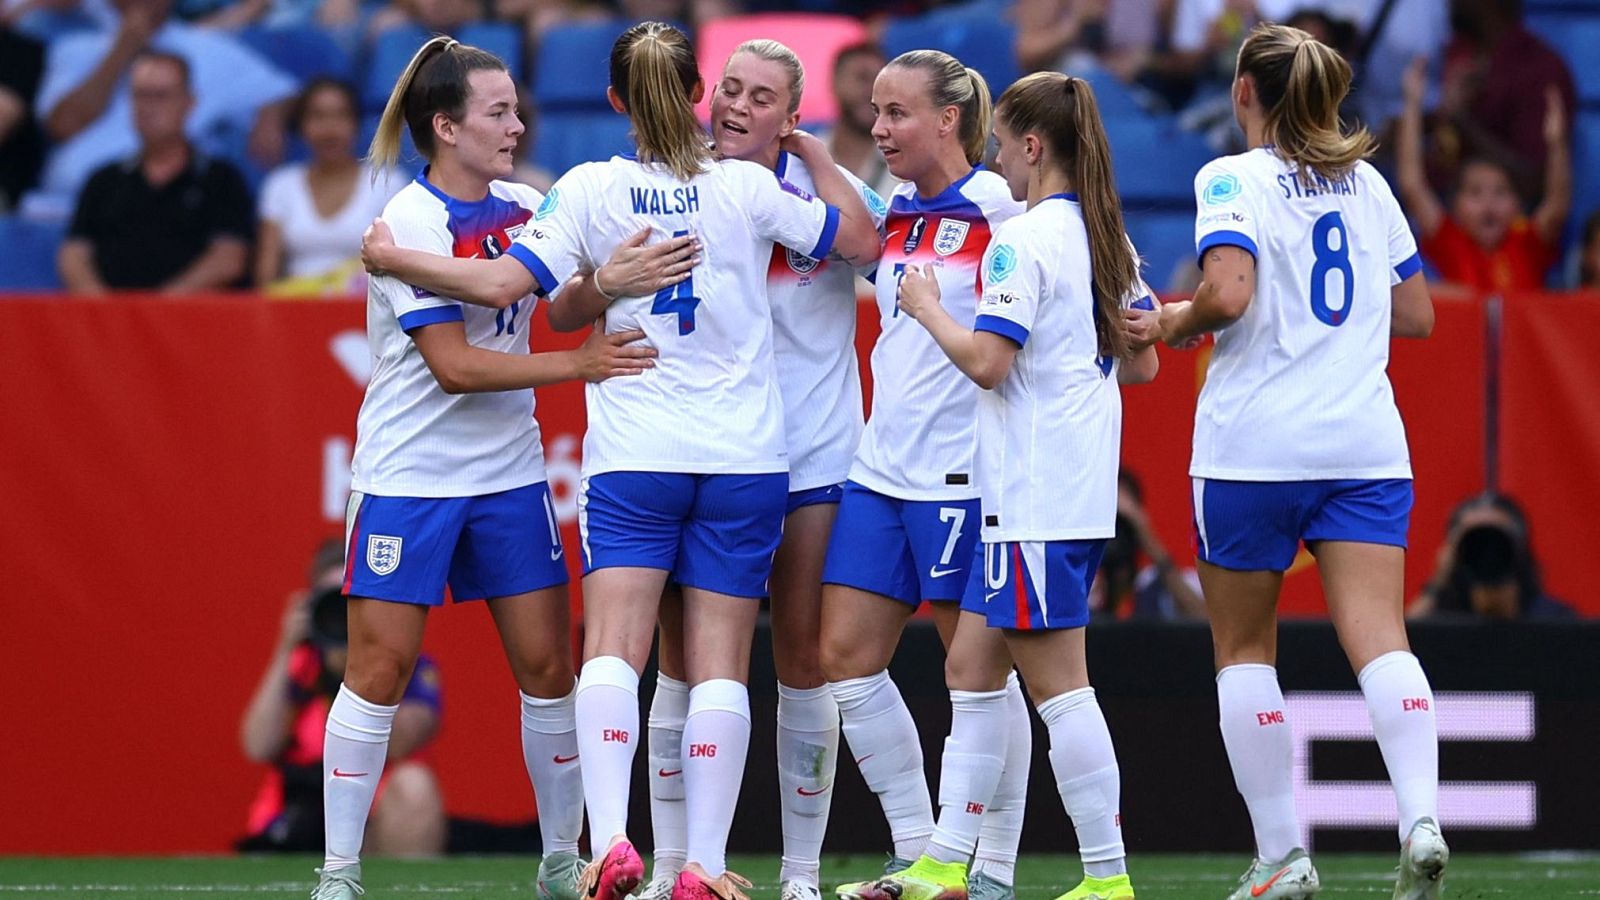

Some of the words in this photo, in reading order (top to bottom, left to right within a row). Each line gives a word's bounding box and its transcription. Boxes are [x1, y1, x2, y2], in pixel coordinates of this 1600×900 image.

[630, 185, 700, 215] WALSH
[1310, 210, 1355, 327] 8
[651, 229, 701, 337] 4
[939, 507, 967, 565] 7
[1402, 697, 1430, 712] ENG
[1256, 710, 1285, 726] ENG
[603, 729, 630, 744] ENG
[689, 744, 717, 758] ENG
[965, 801, 985, 815] ENG
